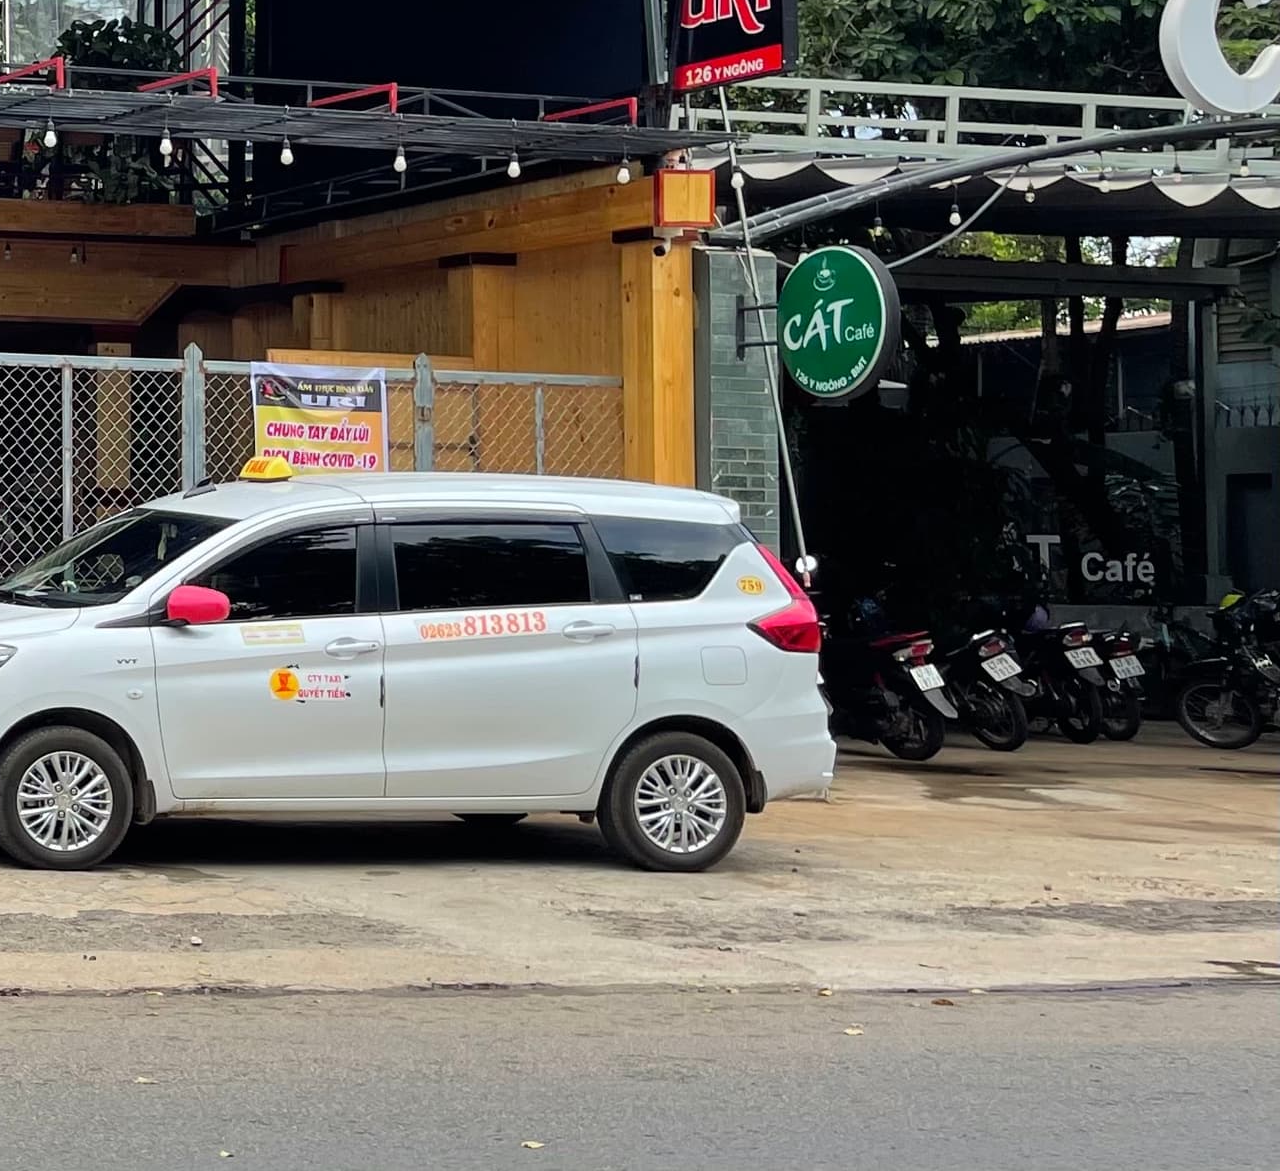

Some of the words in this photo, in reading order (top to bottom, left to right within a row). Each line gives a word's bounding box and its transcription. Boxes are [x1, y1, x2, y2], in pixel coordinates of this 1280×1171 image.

[686, 65, 712, 86] 126
[714, 67, 722, 79] Y
[722, 58, 764, 78] NGÔNG
[783, 298, 854, 351] CÁT
[844, 323, 875, 342] Café
[795, 368, 809, 385] 126
[815, 376, 848, 391] NGÔNG
[850, 356, 867, 378] BMT
[301, 394, 366, 408] URI
[267, 423, 304, 438] CHUNG
[307, 426, 328, 440] TAY
[353, 425, 369, 442] LÙI
[245, 460, 270, 473] TAXI
[322, 453, 354, 467] COVID
[1081, 552, 1155, 582] Café
[740, 580, 762, 591] 759
[307, 674, 322, 683] CTY
[325, 674, 341, 683] TAXI
